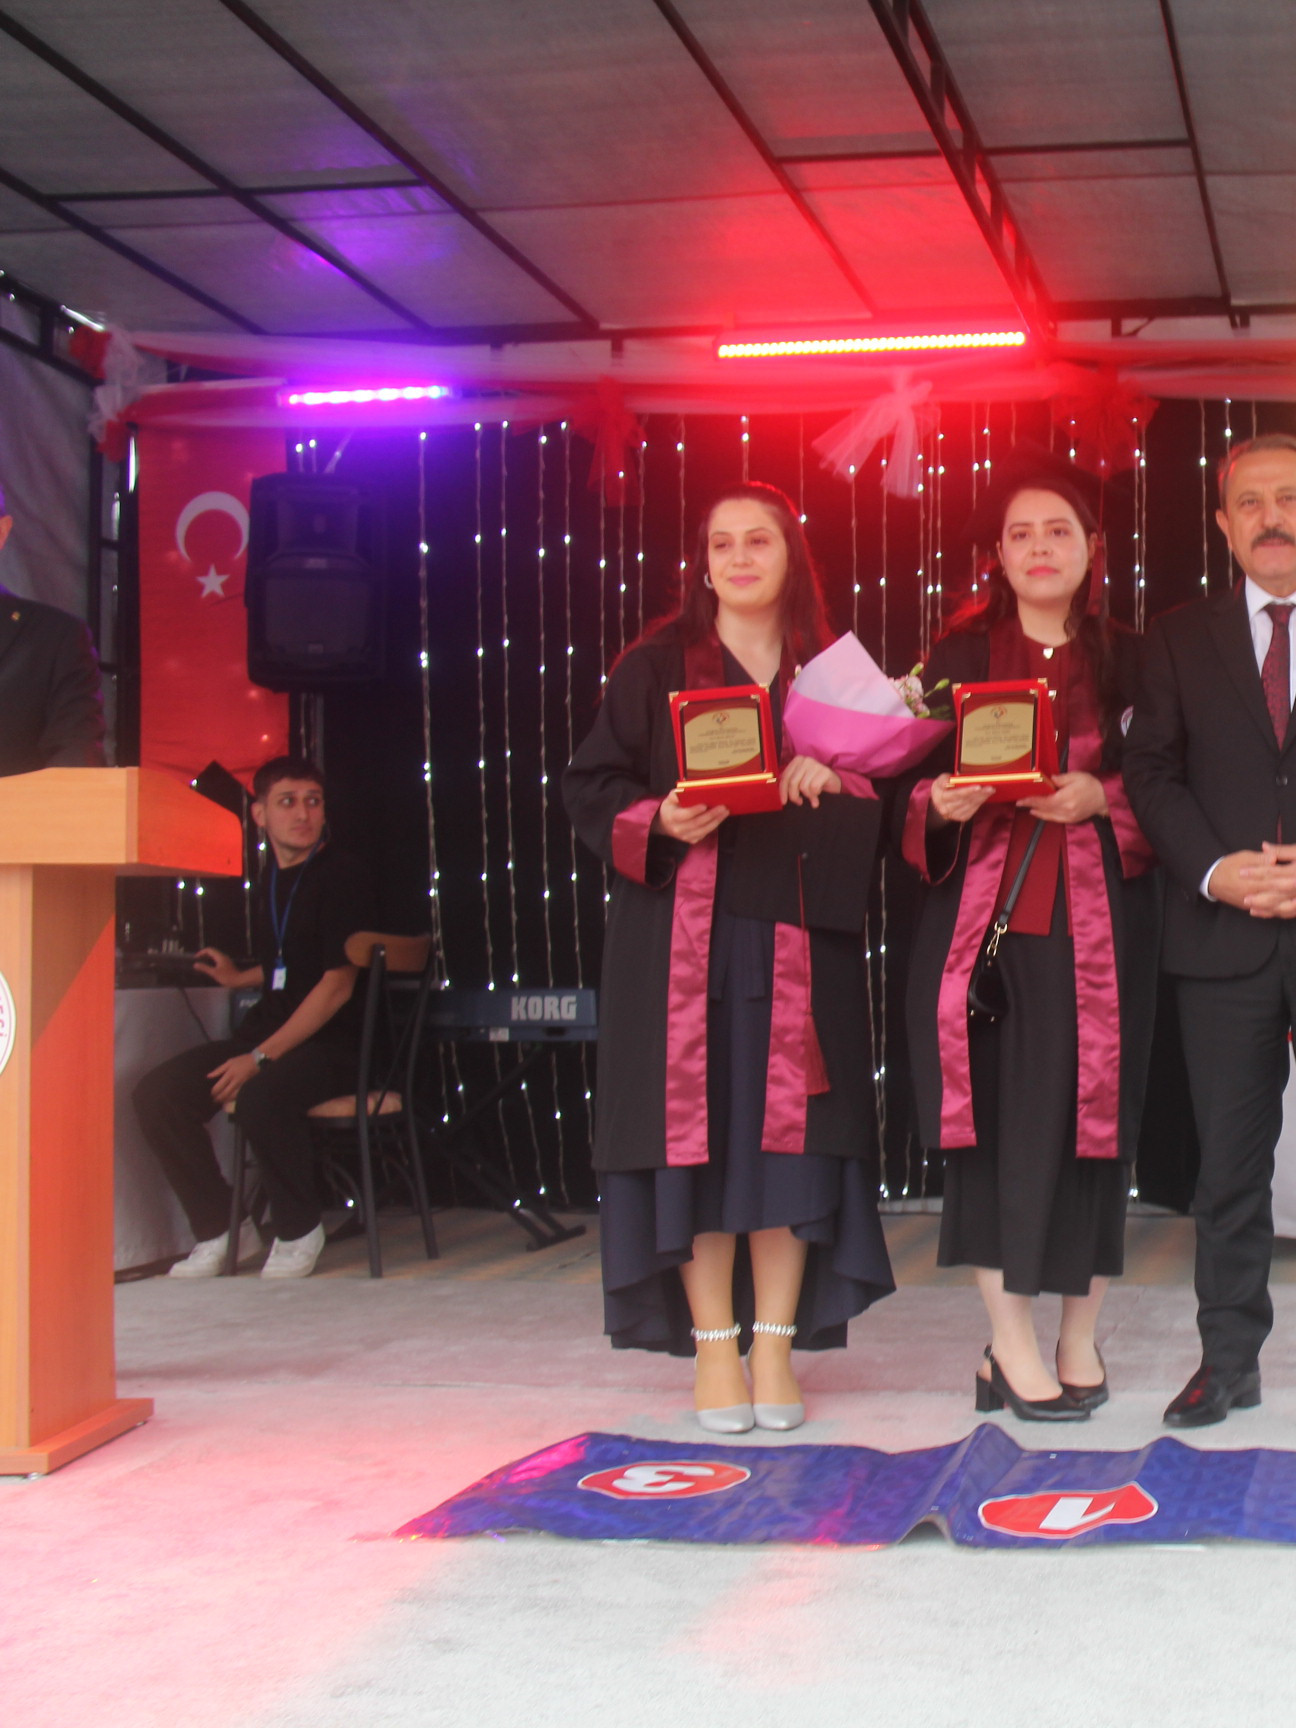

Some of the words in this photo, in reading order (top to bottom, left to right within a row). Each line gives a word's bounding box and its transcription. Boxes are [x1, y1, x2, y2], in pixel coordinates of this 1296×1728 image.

[511, 996, 577, 1021] KORG
[612, 1465, 715, 1493] 3
[1038, 1497, 1116, 1530] 1
